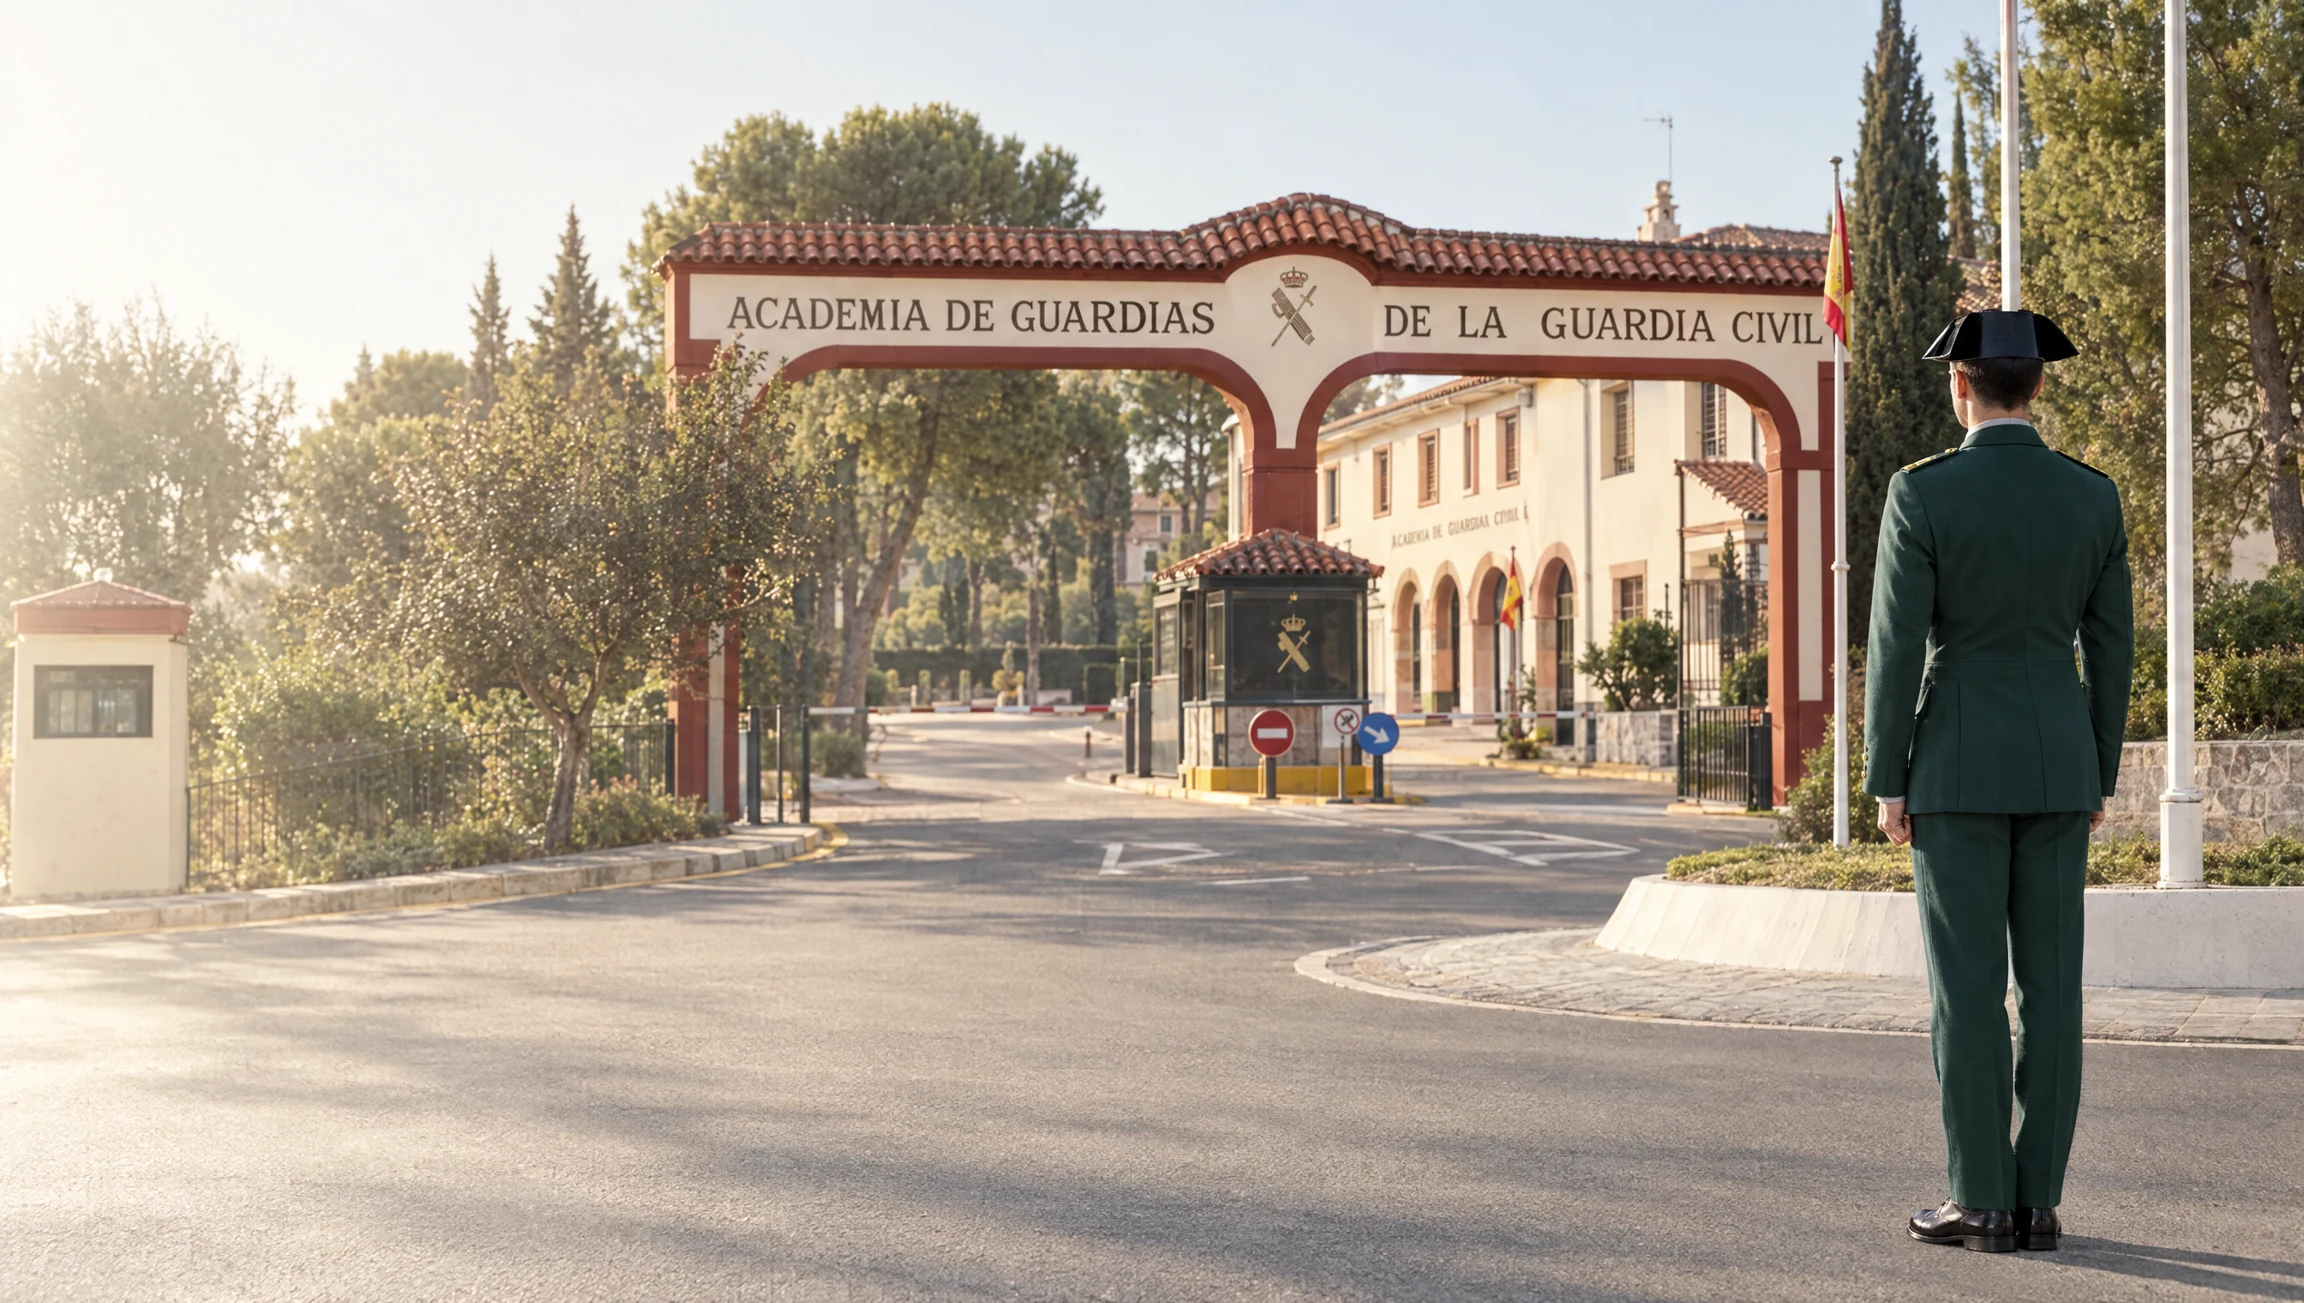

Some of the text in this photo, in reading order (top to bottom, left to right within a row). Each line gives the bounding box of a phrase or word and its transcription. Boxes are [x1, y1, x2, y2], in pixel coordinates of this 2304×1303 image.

[727, 296, 1823, 344] ACADEMIA DE GUARDIAS DE LA GUARDIA CIVIL
